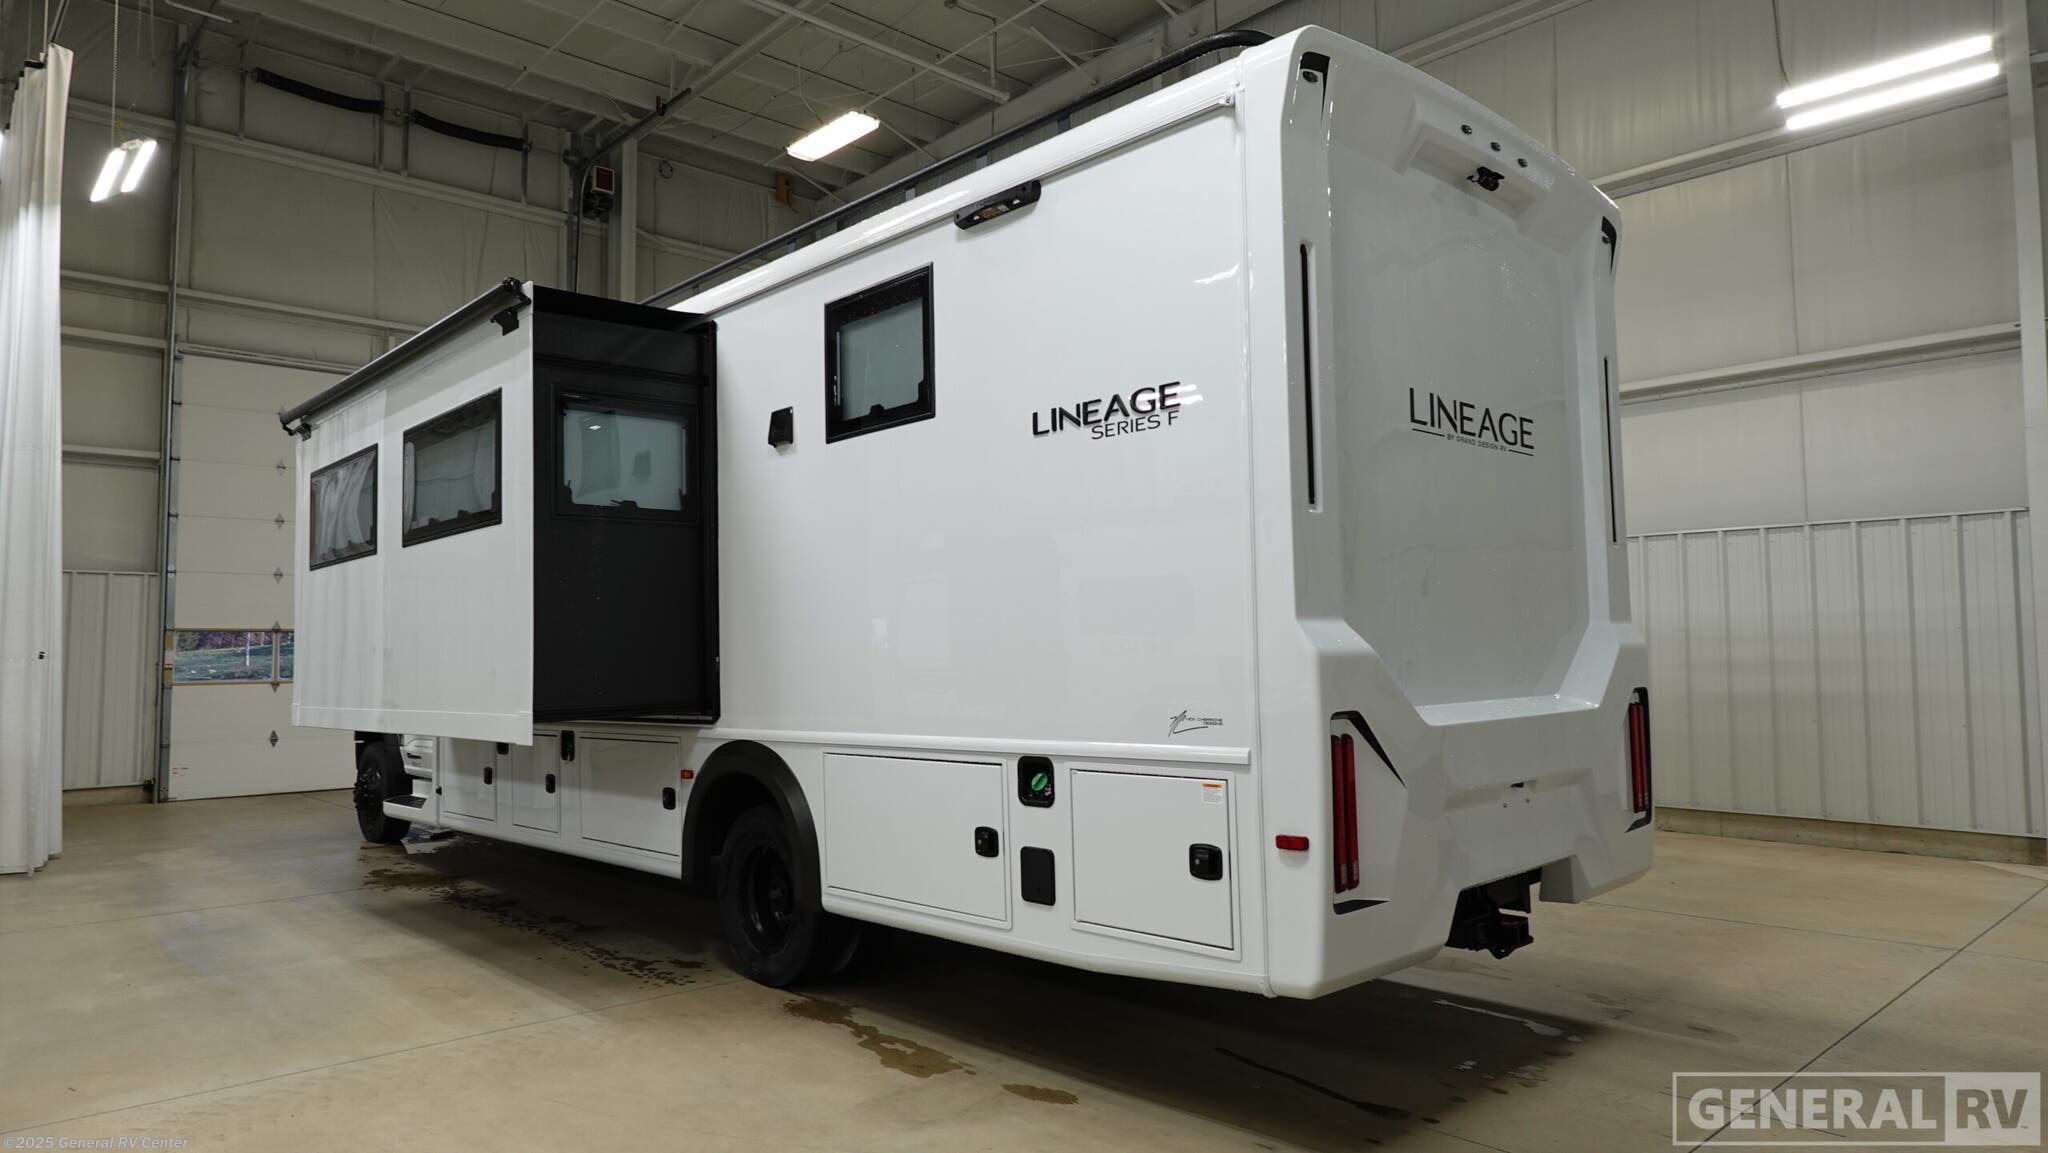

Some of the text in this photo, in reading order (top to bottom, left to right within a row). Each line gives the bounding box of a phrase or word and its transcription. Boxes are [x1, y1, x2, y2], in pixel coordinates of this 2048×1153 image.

[1032, 381, 1181, 436] LINEAGE
[1091, 410, 1180, 440] SERIES F
[1409, 387, 1535, 450] LINEAGE
[1478, 440, 1499, 450] DESIGN
